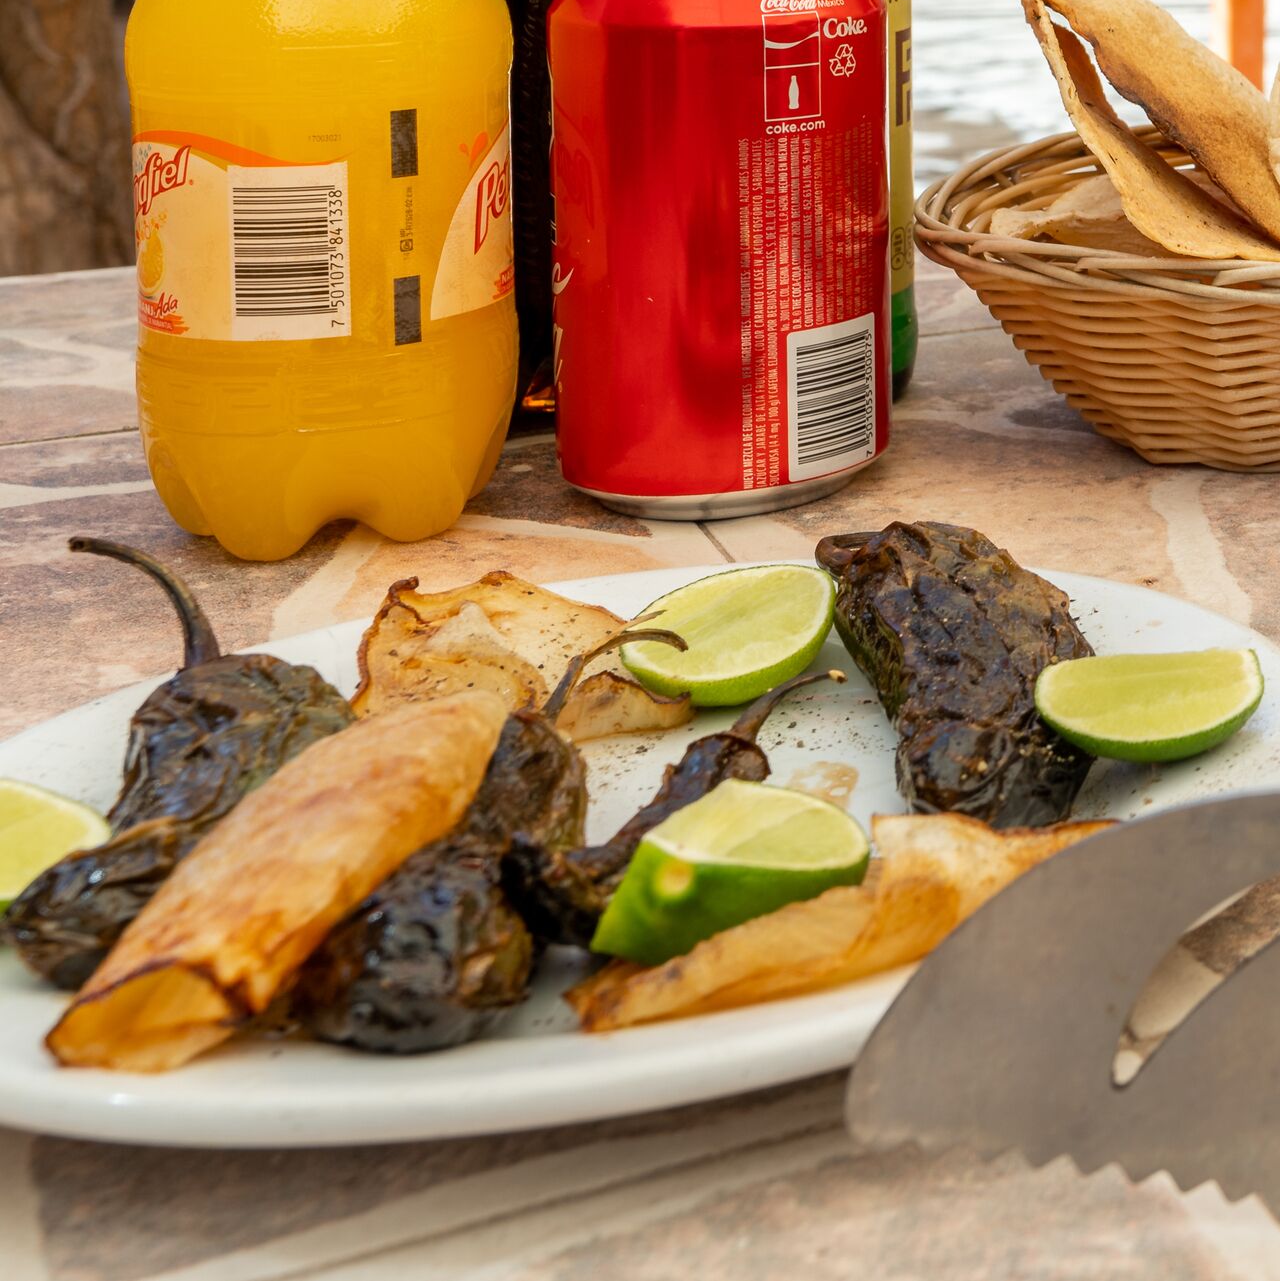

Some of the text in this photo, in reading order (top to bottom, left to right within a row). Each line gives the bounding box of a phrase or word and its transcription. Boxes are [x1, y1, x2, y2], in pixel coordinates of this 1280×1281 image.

[766, 120, 826, 135] coke.com
[328, 189, 346, 328] 7 501073 841338
